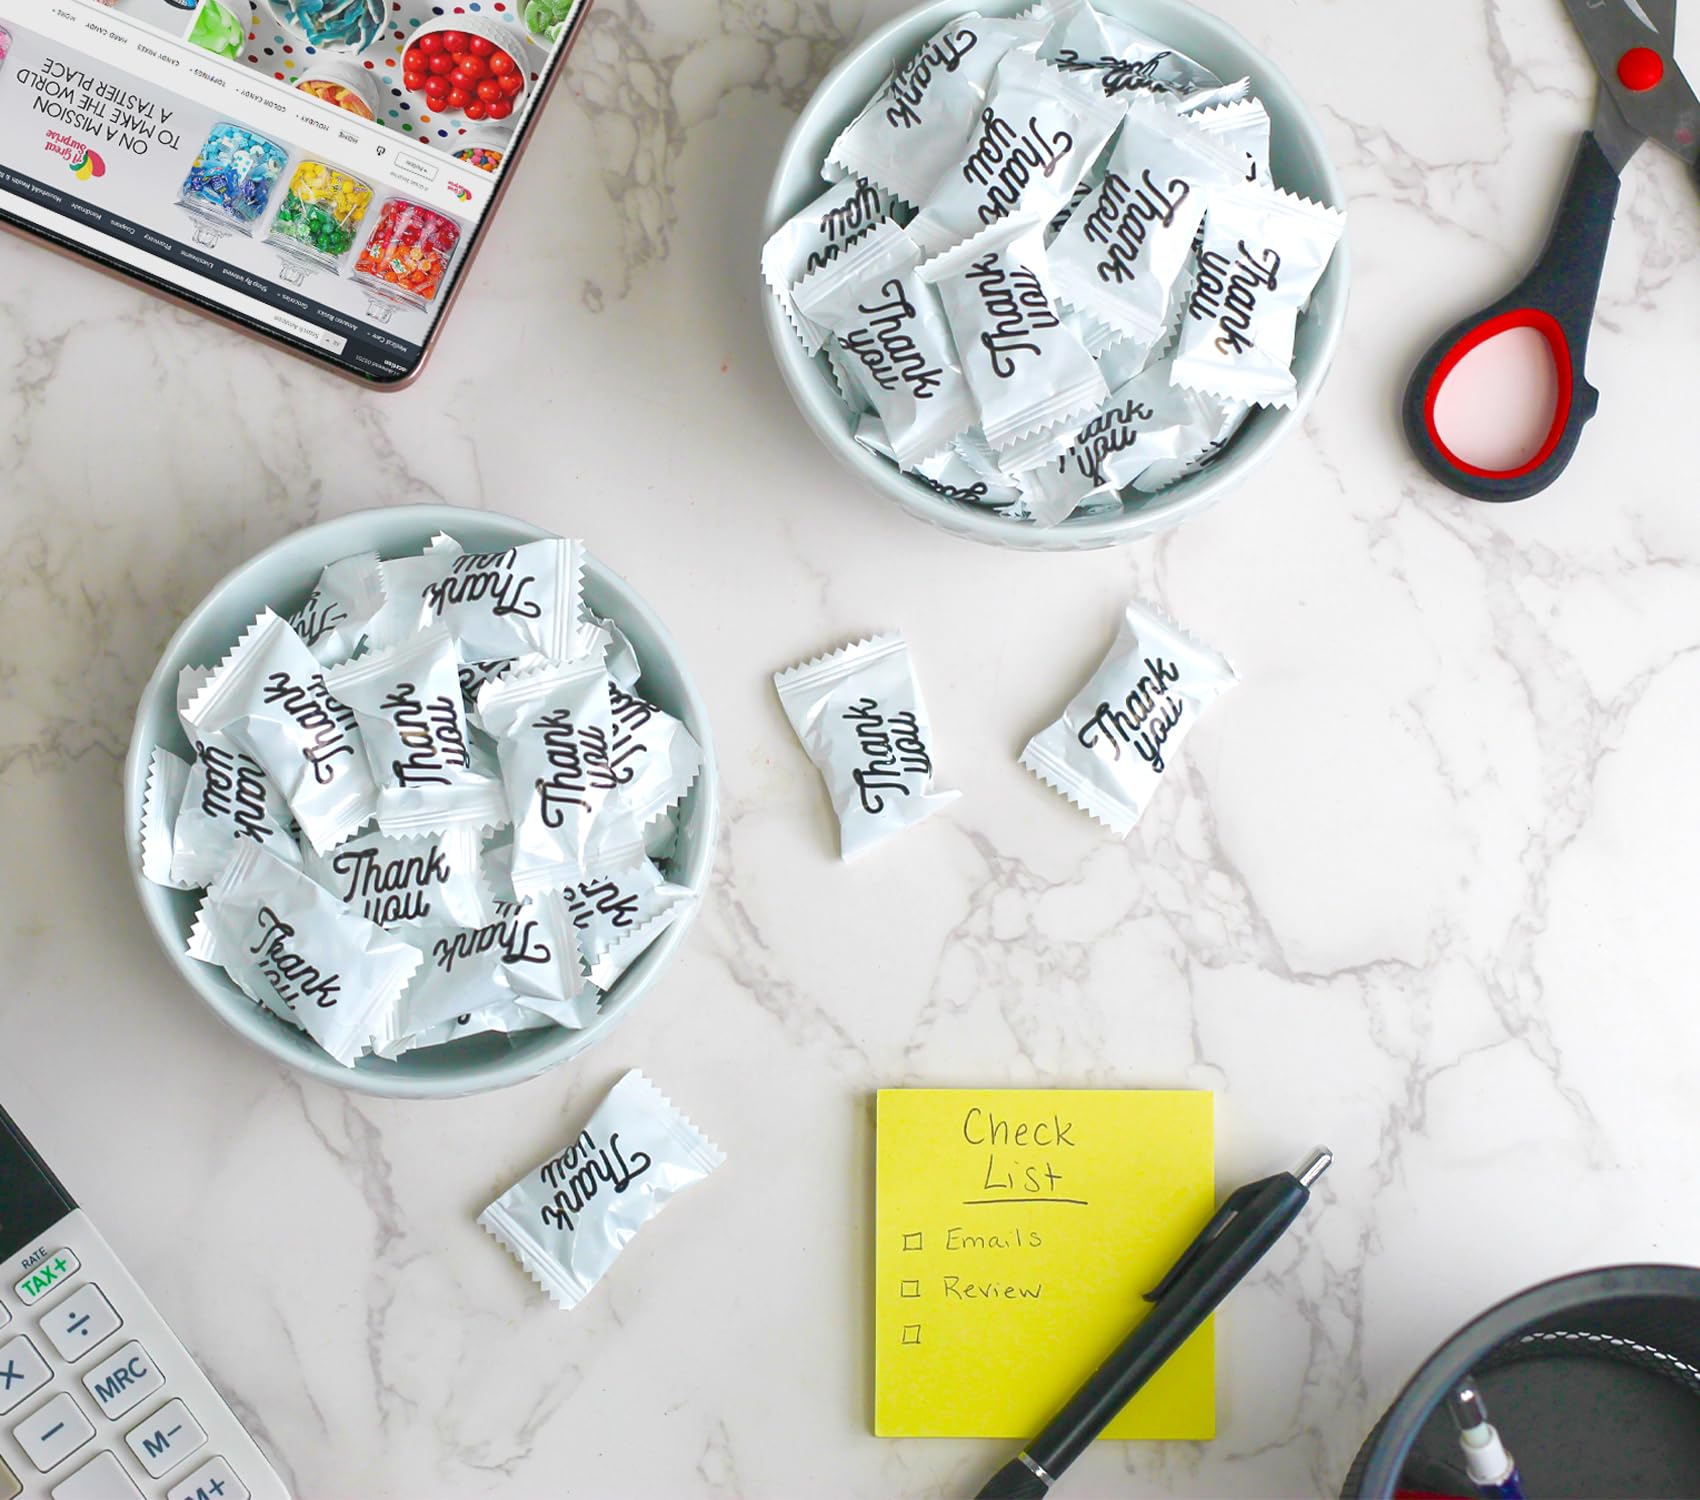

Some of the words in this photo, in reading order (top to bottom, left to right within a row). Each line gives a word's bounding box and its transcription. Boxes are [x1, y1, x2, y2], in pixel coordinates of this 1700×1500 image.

[56, 9, 75, 21] MORE
[85, 22, 107, 35] CANDY
[109, 32, 127, 43] HARD
[137, 43, 156, 56] MIXES
[157, 53, 179, 66] CANDY
[16, 68, 74, 104] WORLD
[41, 57, 94, 91] PLACE
[194, 68, 225, 87] TOPPINGS
[886, 29, 978, 129] Thank
[77, 93, 106, 118] THE
[95, 80, 154, 118] TASTIER
[240, 90, 263, 102] CANDY
[263, 98, 286, 112] COLOR
[32, 95, 102, 136] MISSION
[109, 107, 156, 138] MAKE
[160, 107, 173, 123] A
[301, 115, 329, 131] HOLIDAY
[45, 129, 86, 155] Surprise
[106, 125, 118, 141] A
[118, 132, 147, 154] ON
[157, 129, 180, 150] TO
[338, 131, 358, 144] HOME
[44, 141, 72, 160] Great
[963, 107, 1017, 186] you
[71, 153, 85, 167] A
[977, 116, 1074, 225] Thank
[11, 176, 30, 189] Health
[70, 202, 101, 220] Handmade
[820, 176, 881, 242] you
[110, 219, 135, 234] Coupons
[1097, 169, 1190, 284] Thank
[143, 233, 171, 250] Pharmacy
[180, 250, 214, 268] Livestreams
[222, 268, 244, 281] Interest
[244, 277, 252, 285] By
[252, 281, 267, 292] Shop
[282, 294, 308, 309] Groceries
[1214, 240, 1282, 356] Thank
[273, 315, 298, 329] Amazon
[317, 309, 334, 321] Basics
[334, 316, 357, 330] Amazon
[965, 252, 1042, 379] Thank
[298, 326, 319, 339] Search
[371, 333, 385, 343] Care
[858, 278, 944, 400] Thank
[385, 339, 407, 352] Medical
[837, 328, 900, 391] you
[422, 571, 542, 619] Thank
[1077, 656, 1180, 762] Thank
[263, 671, 354, 785] Thank
[380, 683, 453, 789] Thank
[426, 695, 471, 769] you
[1133, 697, 1185, 774] you
[532, 708, 593, 829] Thank
[841, 697, 911, 815] Thank
[195, 739, 235, 818] you
[332, 844, 451, 904] Thank
[250, 905, 342, 1009] Thank
[432, 919, 552, 973] Thank
[962, 1107, 1077, 1148] Check
[540, 1132, 652, 1232] Thank
[983, 1153, 1064, 1194] List
[944, 1227, 1043, 1251] Emails
[20, 1246, 48, 1270] RATE
[21, 1257, 69, 1298] TAX+
[943, 1275, 1044, 1300] Review
[93, 1356, 148, 1403] MRC
